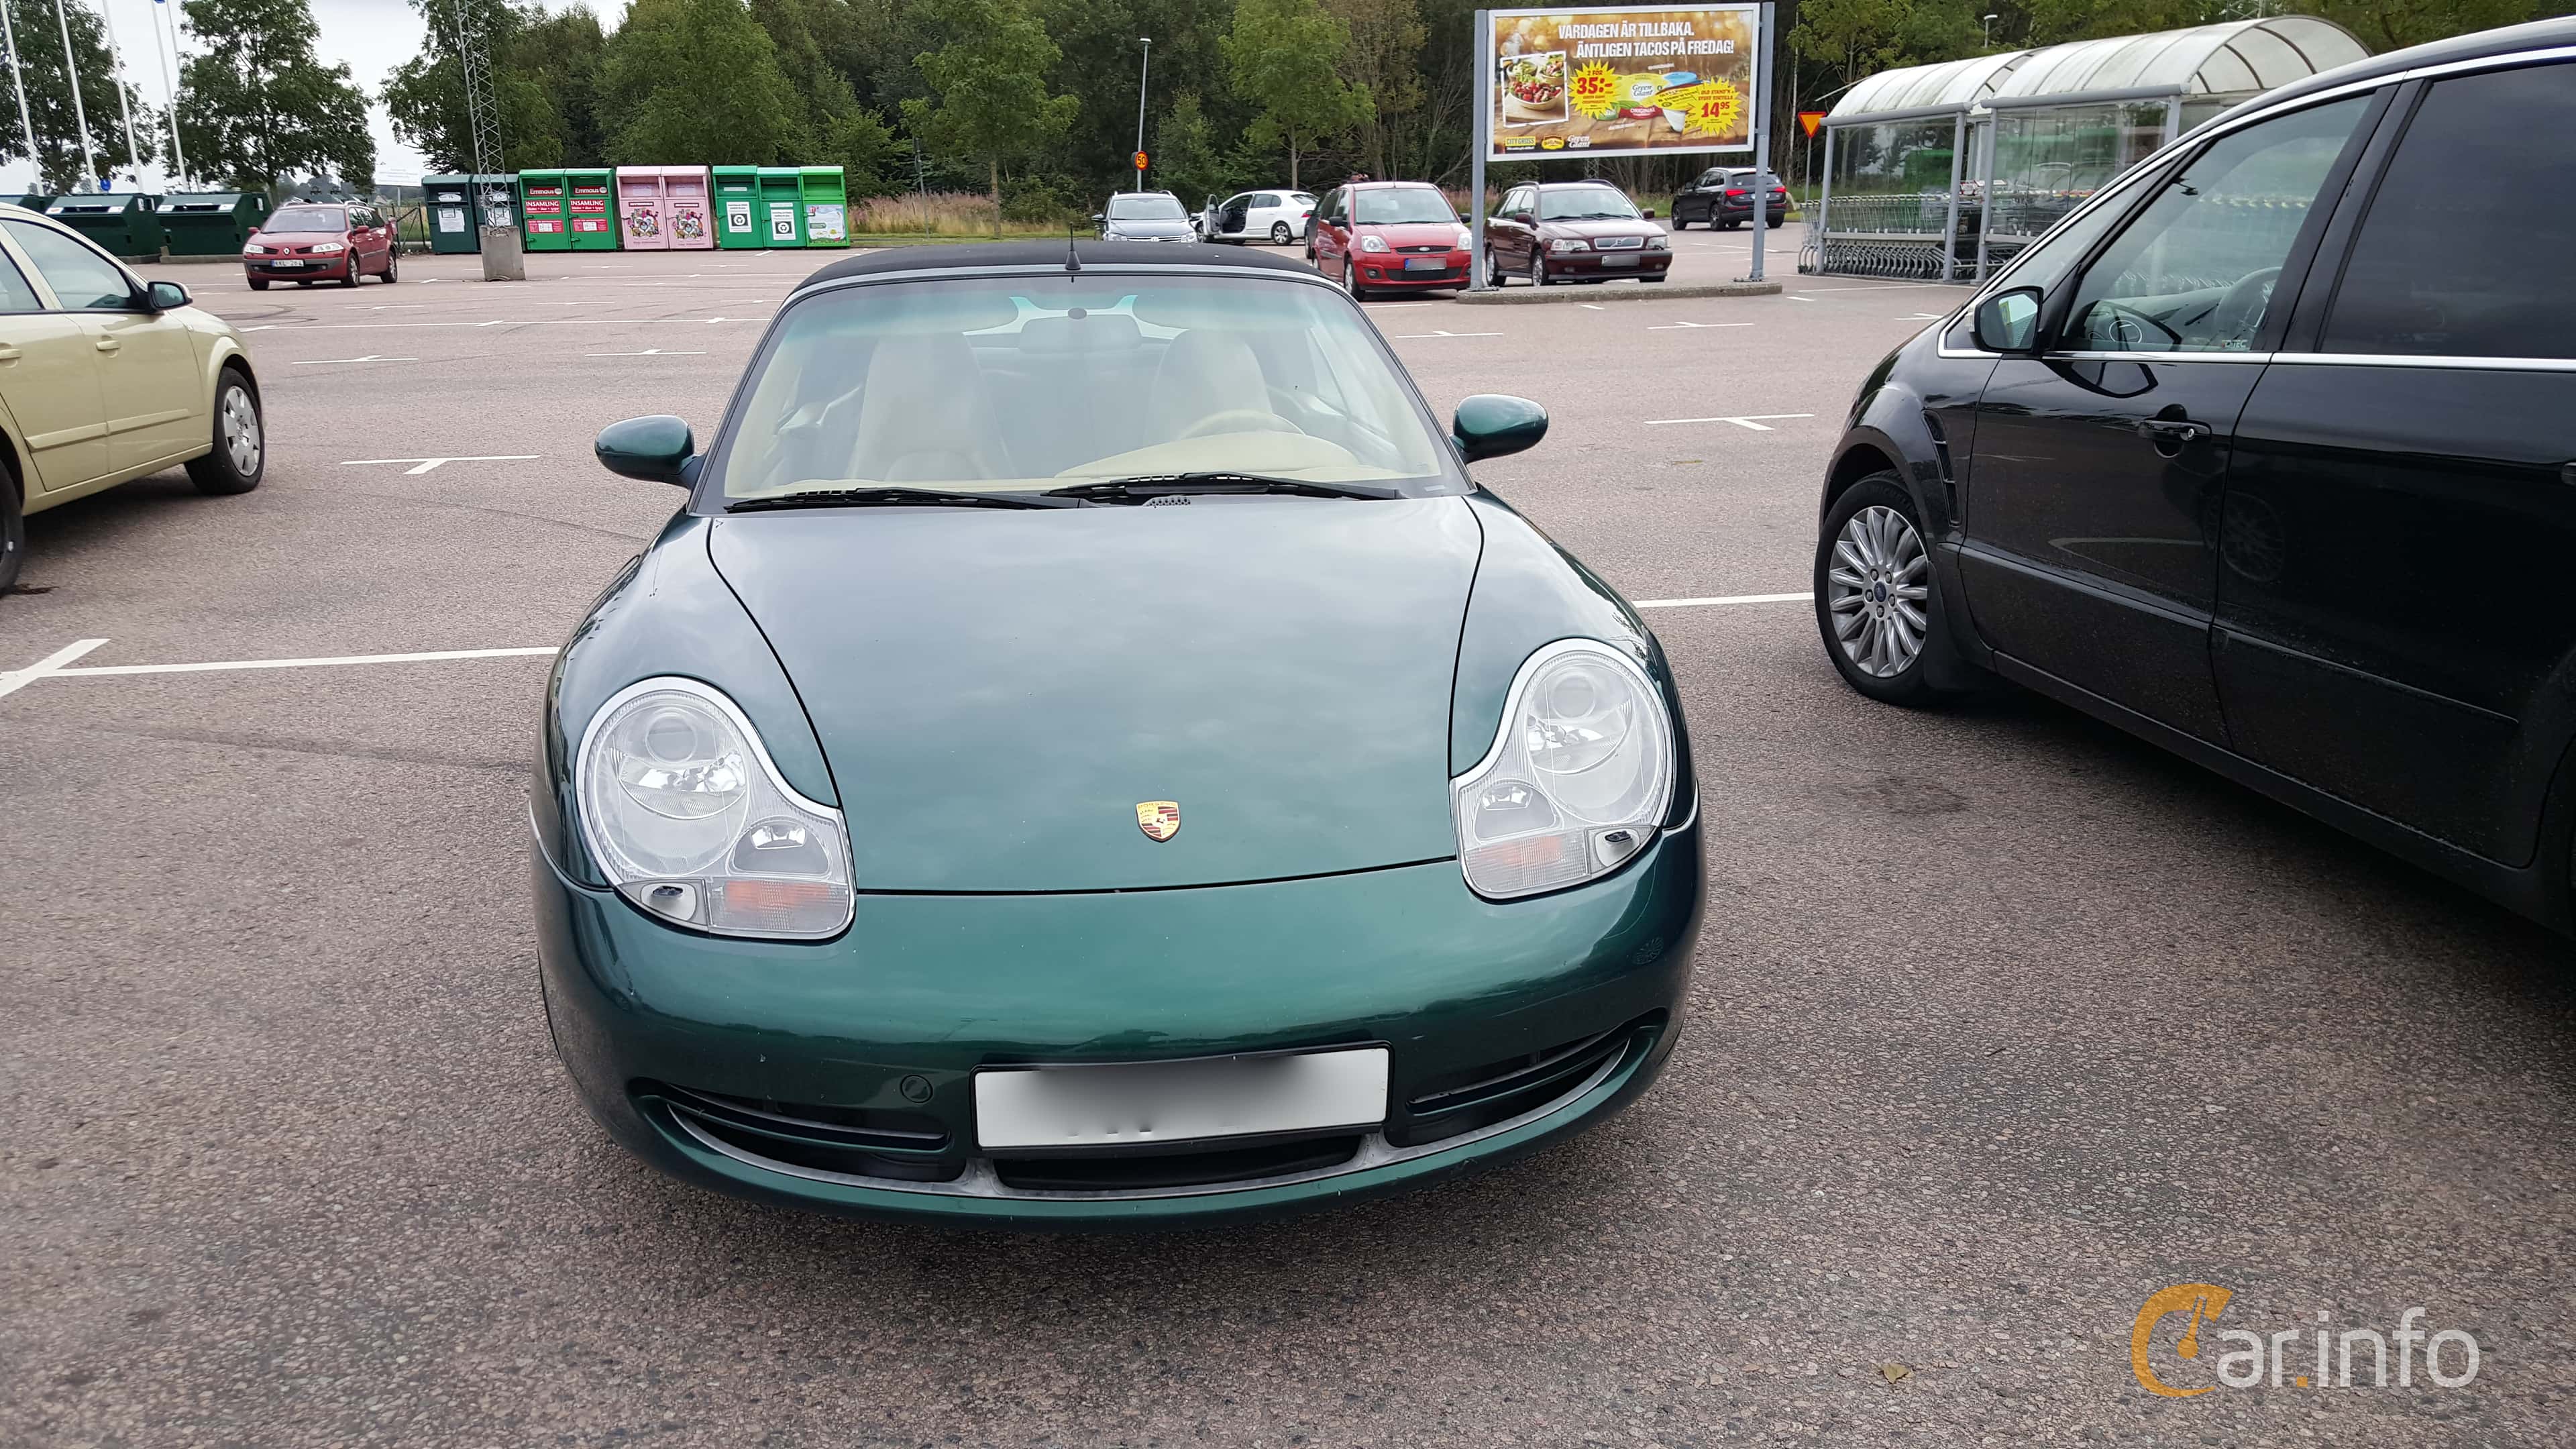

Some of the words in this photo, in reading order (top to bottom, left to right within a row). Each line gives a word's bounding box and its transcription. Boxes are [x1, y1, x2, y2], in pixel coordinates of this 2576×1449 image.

[1558, 24, 1619, 39] VARDAGEN
[1621, 20, 1636, 38] ÄR
[1638, 21, 1695, 37] TILLBAKA.
[1576, 41, 1632, 58] ÄNTLIGEN
[1633, 42, 1670, 56] TACOS
[1670, 37, 1686, 55] PÅ
[1687, 40, 1734, 55] FREDAG!
[1577, 76, 1613, 95] 35:-
[1701, 102, 1719, 118] 14
[1137, 156, 1145, 165] 50
